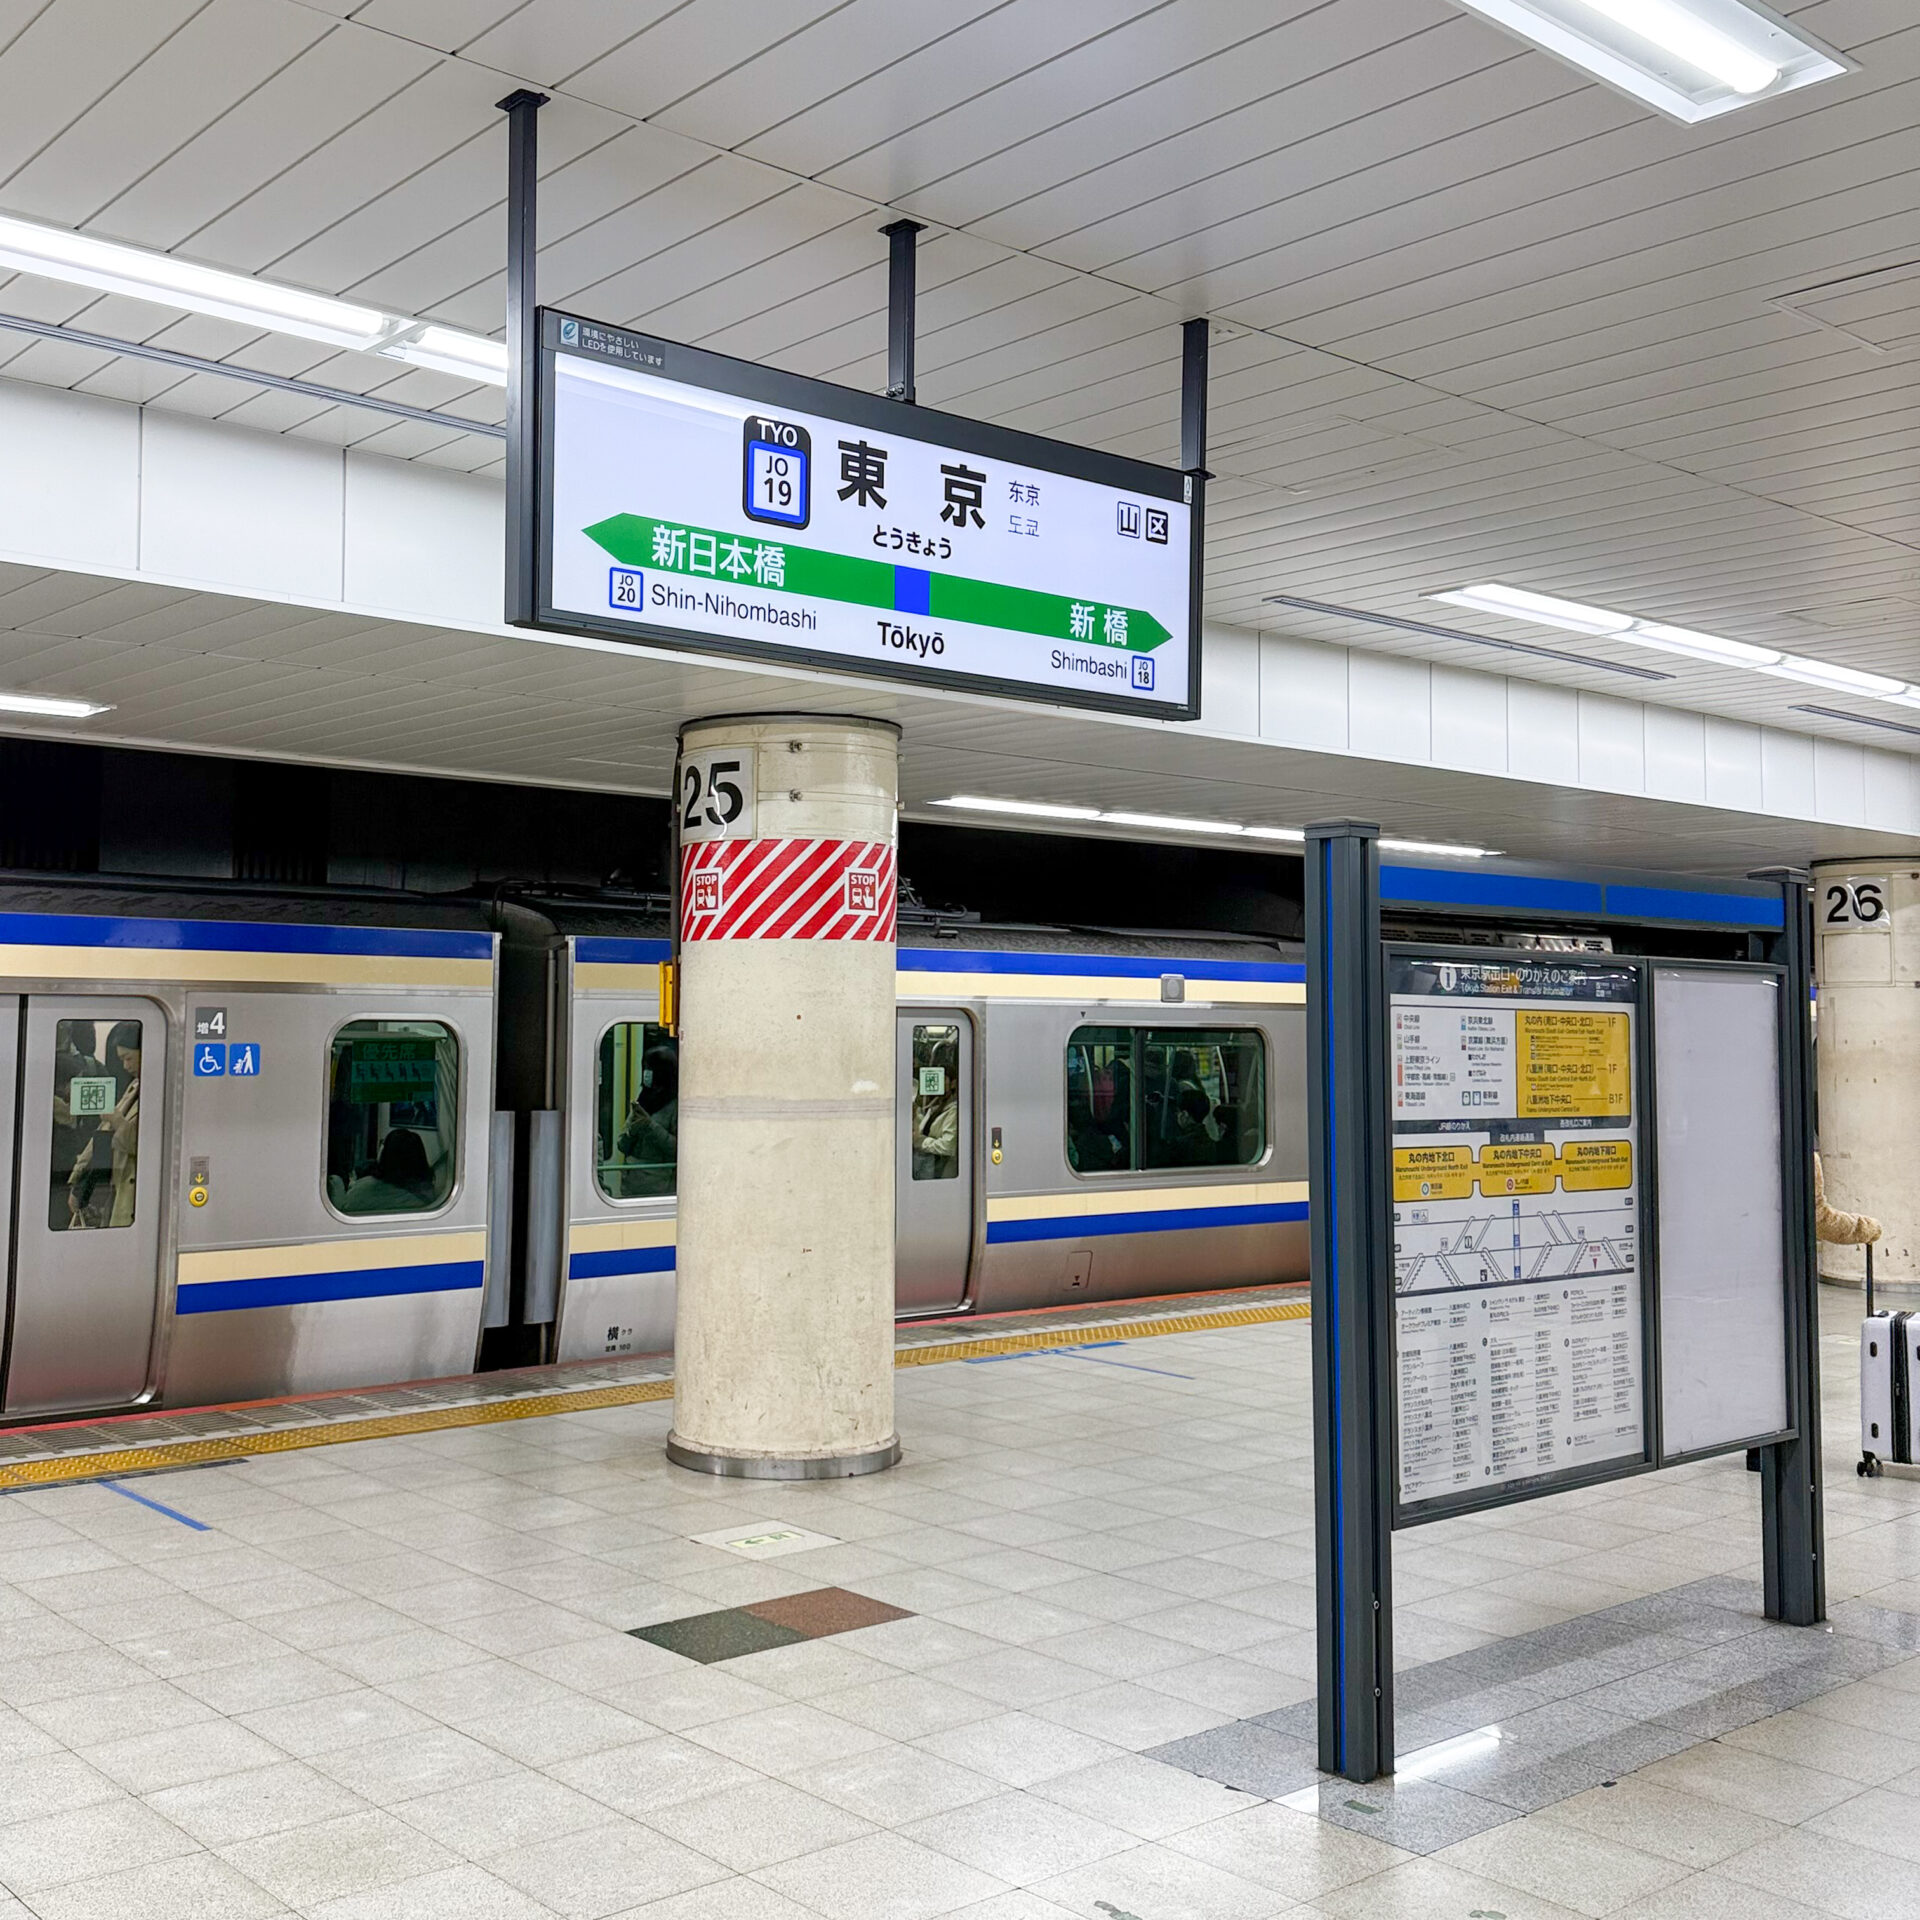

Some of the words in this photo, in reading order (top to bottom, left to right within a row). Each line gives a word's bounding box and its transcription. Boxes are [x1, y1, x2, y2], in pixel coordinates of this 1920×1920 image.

[582, 339, 663, 366] LEDを使用しています
[756, 419, 798, 447] TYO
[766, 455, 788, 476] JO
[763, 478, 792, 506] 19
[837, 440, 986, 529] 東京
[1008, 480, 1041, 507] 东京
[1008, 514, 1040, 538] 도쿄
[872, 524, 952, 560] とうきょう
[651, 525, 786, 588] 新日本橋
[617, 586, 636, 604] 20
[619, 575, 634, 587] JO
[651, 583, 818, 630] Shin-Nihombashi
[1069, 602, 1128, 647] 新橋
[877, 621, 945, 658] Tōkyō
[1051, 651, 1128, 679] Shimbashi
[1137, 671, 1150, 685] 18
[1138, 661, 1148, 671] JO
[684, 761, 743, 829] 25
[696, 875, 717, 886] STOP
[851, 875, 875, 886] STOP
[1827, 884, 1883, 923] 26
